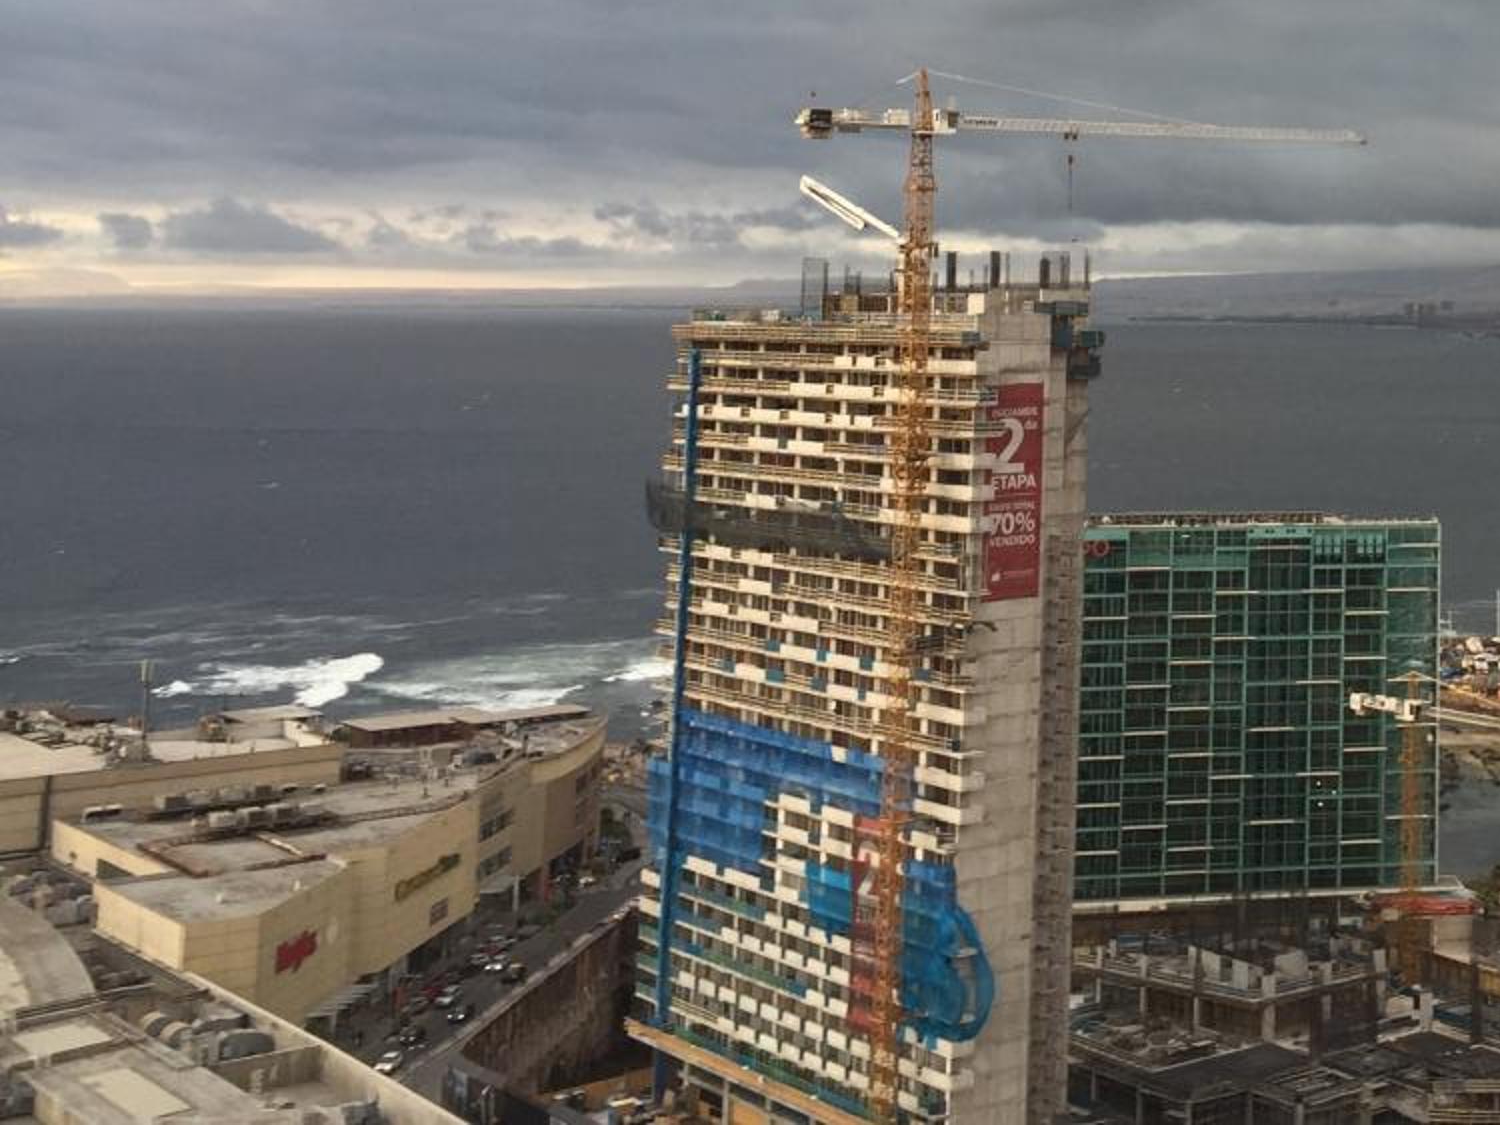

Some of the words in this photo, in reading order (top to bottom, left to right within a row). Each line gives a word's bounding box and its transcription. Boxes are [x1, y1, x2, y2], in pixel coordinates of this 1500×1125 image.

[991, 473, 1037, 490] ETAPA
[990, 510, 1036, 536] 70%
[989, 534, 1036, 548] VENDIDO
